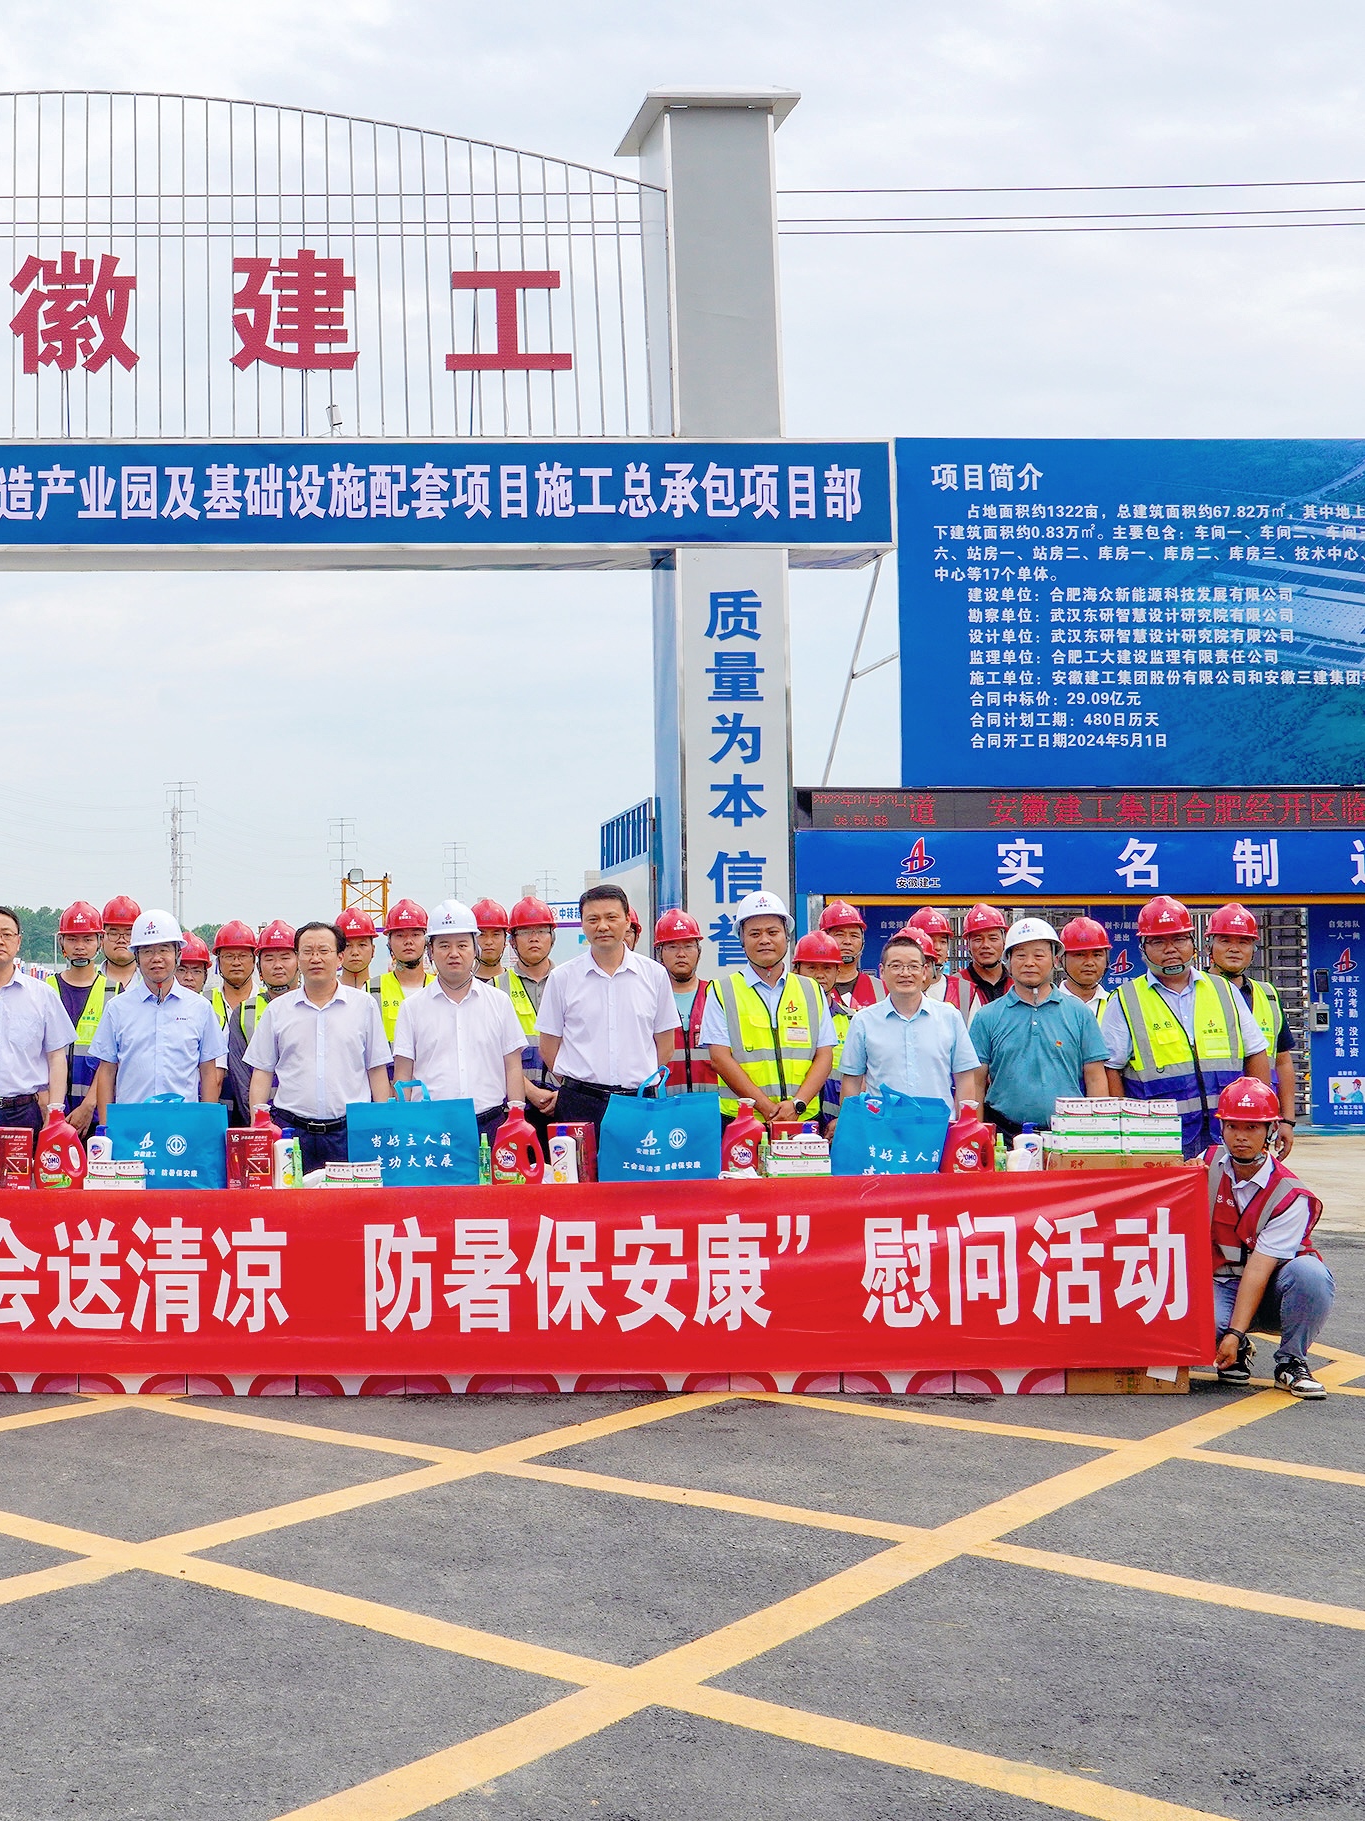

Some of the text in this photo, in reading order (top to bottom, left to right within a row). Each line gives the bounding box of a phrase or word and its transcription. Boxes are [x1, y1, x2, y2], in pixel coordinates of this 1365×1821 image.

[931, 462, 1044, 492] 项目简介
[934, 567, 1058, 582] 中心等17个单体。
[968, 587, 1293, 603] 建设单位：合肥海众新能源科技发展有限公司
[968, 608, 1294, 623] 勘察单位：武汉东研智慧设计研究院有限公司
[968, 628, 1295, 645] 设计单位：武汉东研智慧设计研究院有限公司
[969, 649, 1279, 665] 监理单位：合肥工大建设监理有限责任公司
[970, 670, 1365, 686] 施工单位：安徽建工集团股份有限公司和安徽三建集团
[970, 691, 1141, 707] 合同中标价：29.09亿元
[704, 589, 767, 827] 质量为本
[970, 712, 1160, 728] 合同计划工期：480日历天
[970, 733, 1168, 749] 合同开工日期2024年5月1日
[987, 792, 1365, 826] 安徽建工集团合肥经开区临
[896, 877, 941, 889] 安徽建工
[1334, 988, 1344, 1019] 不打卡
[365, 1212, 811, 1333] 防暑保安康”
[861, 1205, 1192, 1329] 慰问活动
